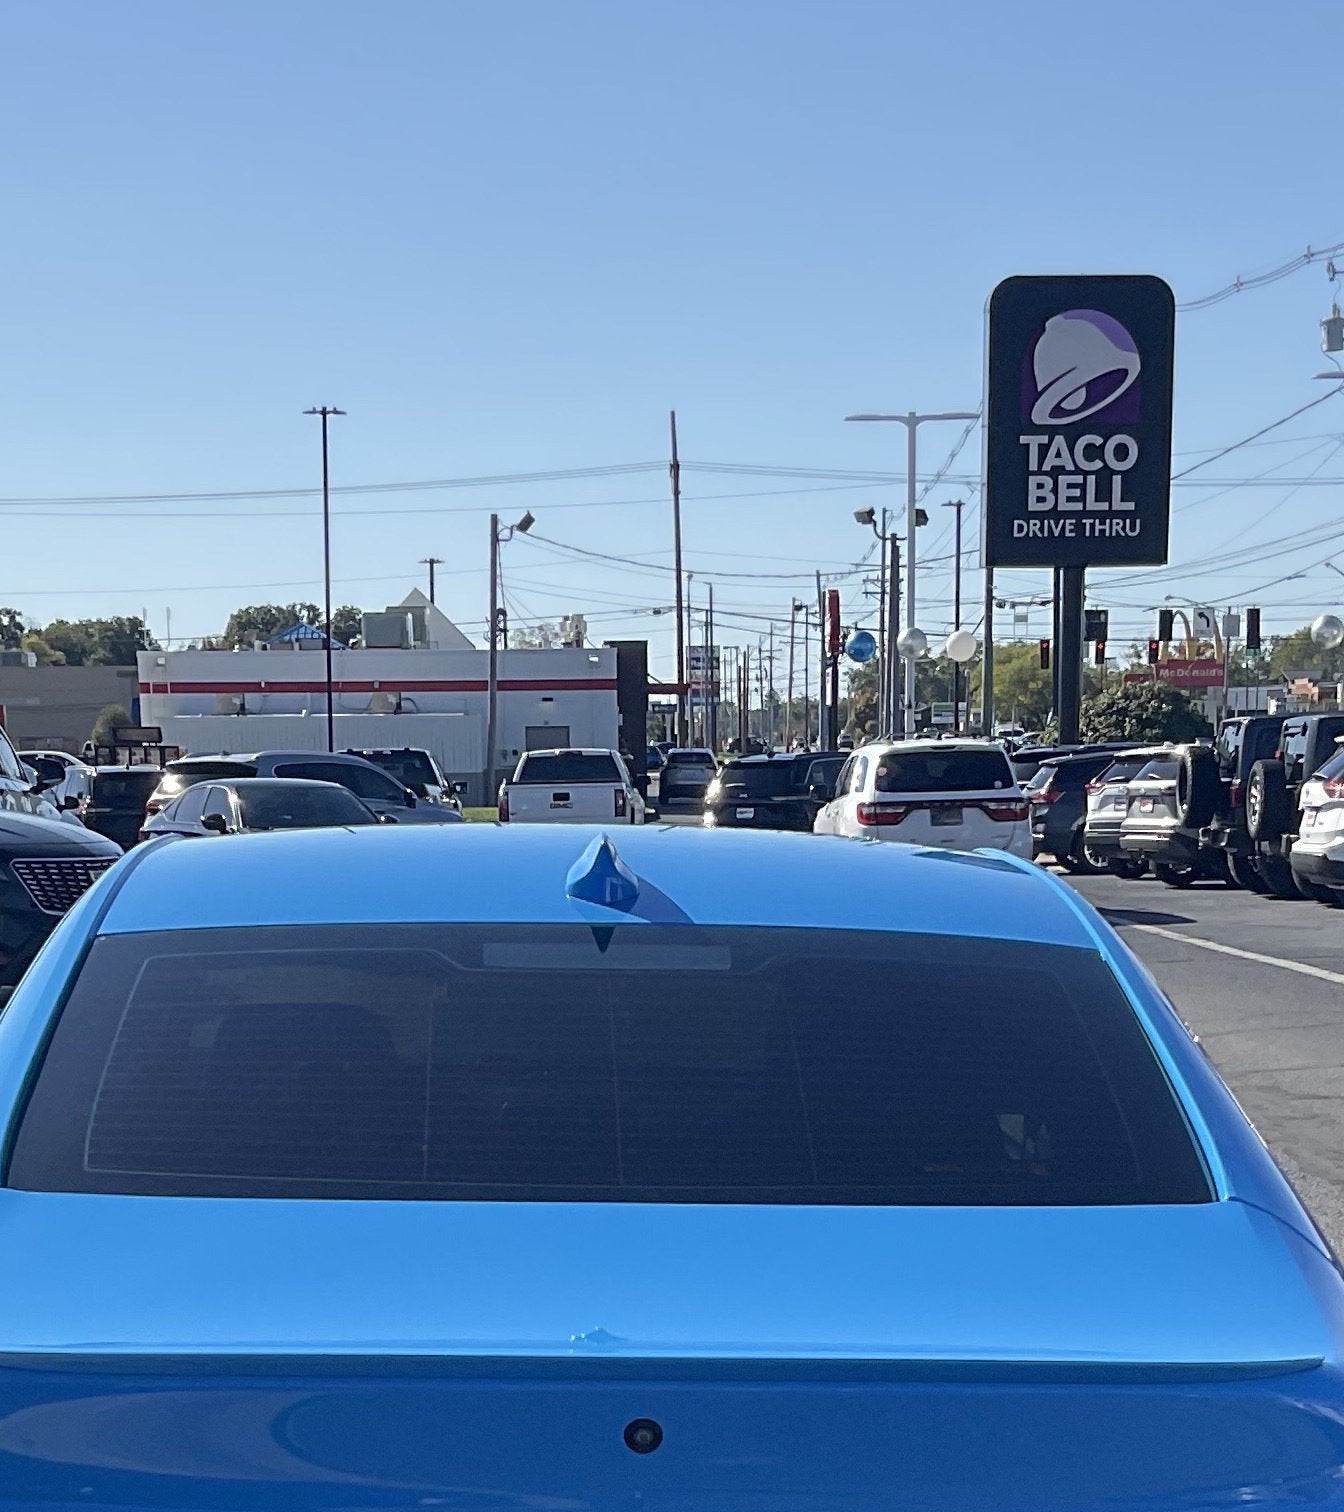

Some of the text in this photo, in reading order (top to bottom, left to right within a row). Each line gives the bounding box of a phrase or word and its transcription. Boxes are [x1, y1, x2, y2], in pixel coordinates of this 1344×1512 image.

[1020, 434, 1138, 471] TACO
[1027, 474, 1136, 512] BELL
[1012, 518, 1141, 538] DRIVE THRU
[1159, 667, 1224, 680] McDonald's
